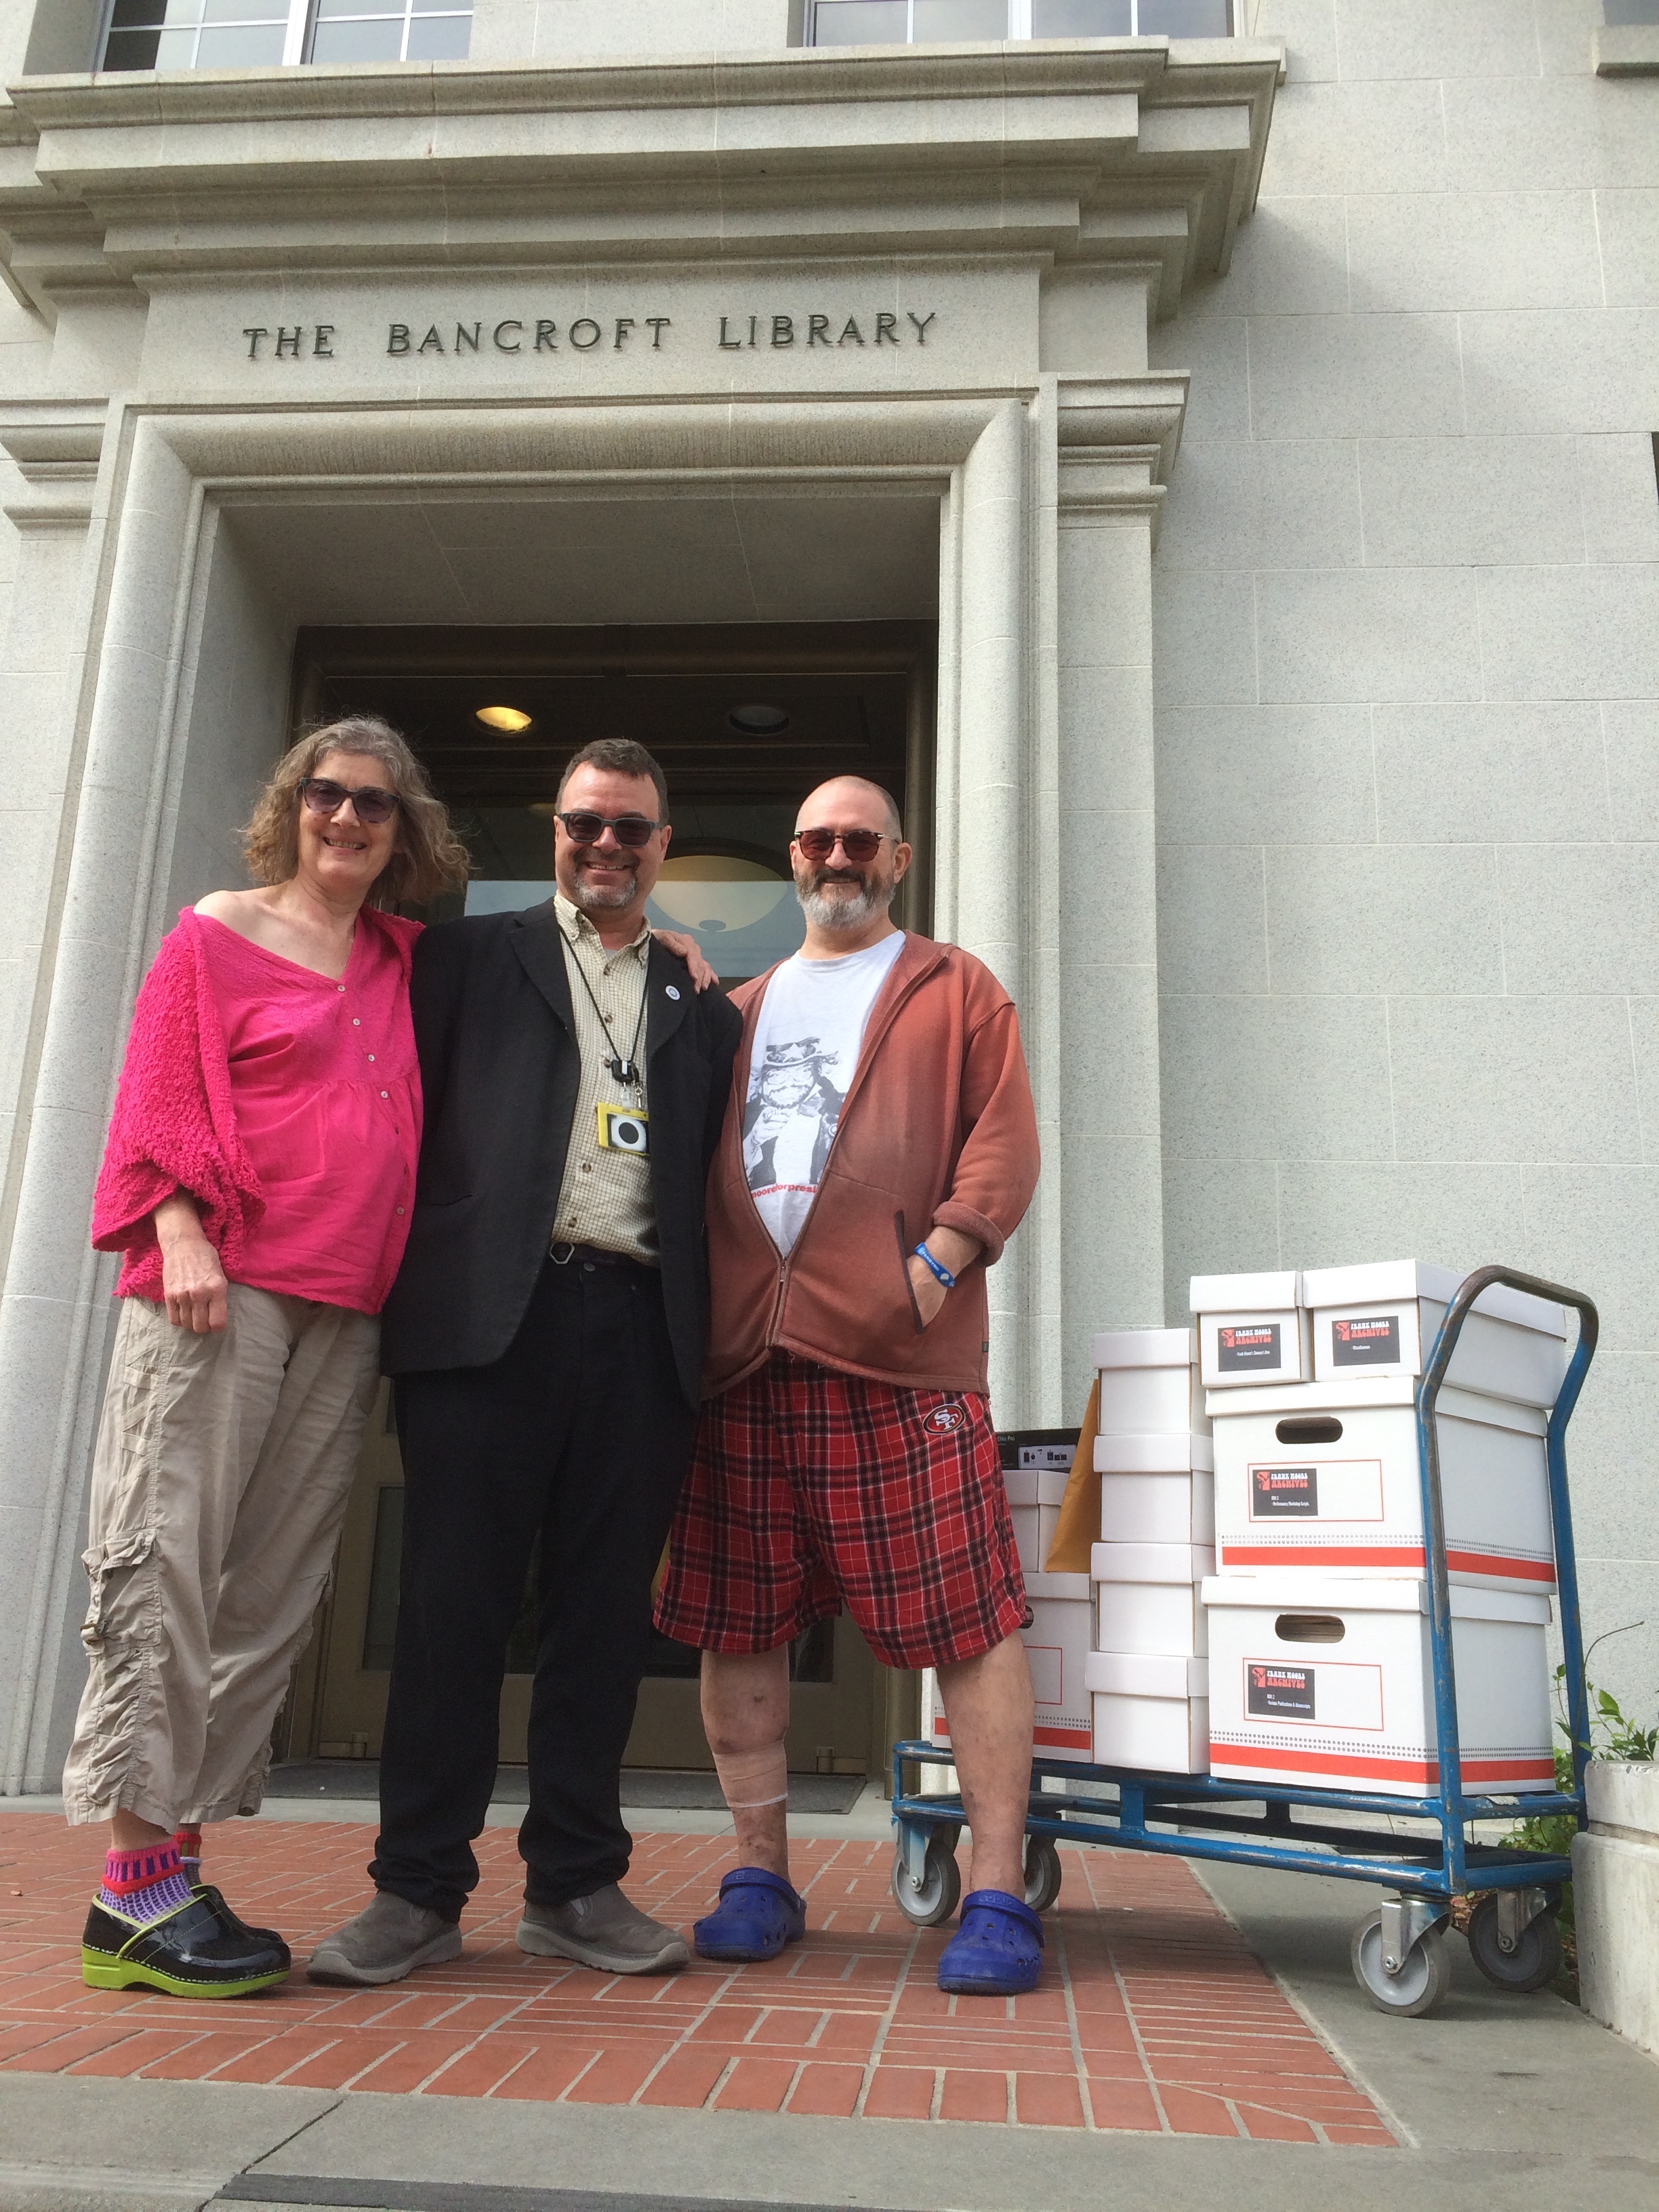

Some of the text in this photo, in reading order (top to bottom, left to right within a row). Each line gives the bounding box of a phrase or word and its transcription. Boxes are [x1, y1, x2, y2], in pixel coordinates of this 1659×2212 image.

[243, 312, 936, 358] THE BANCROFT LIBRARY
[1351, 1328, 1390, 1338] ARCHIVES
[1271, 1479, 1309, 1488] ARCHIVES
[1267, 1677, 1305, 1689] ARCHIVES
